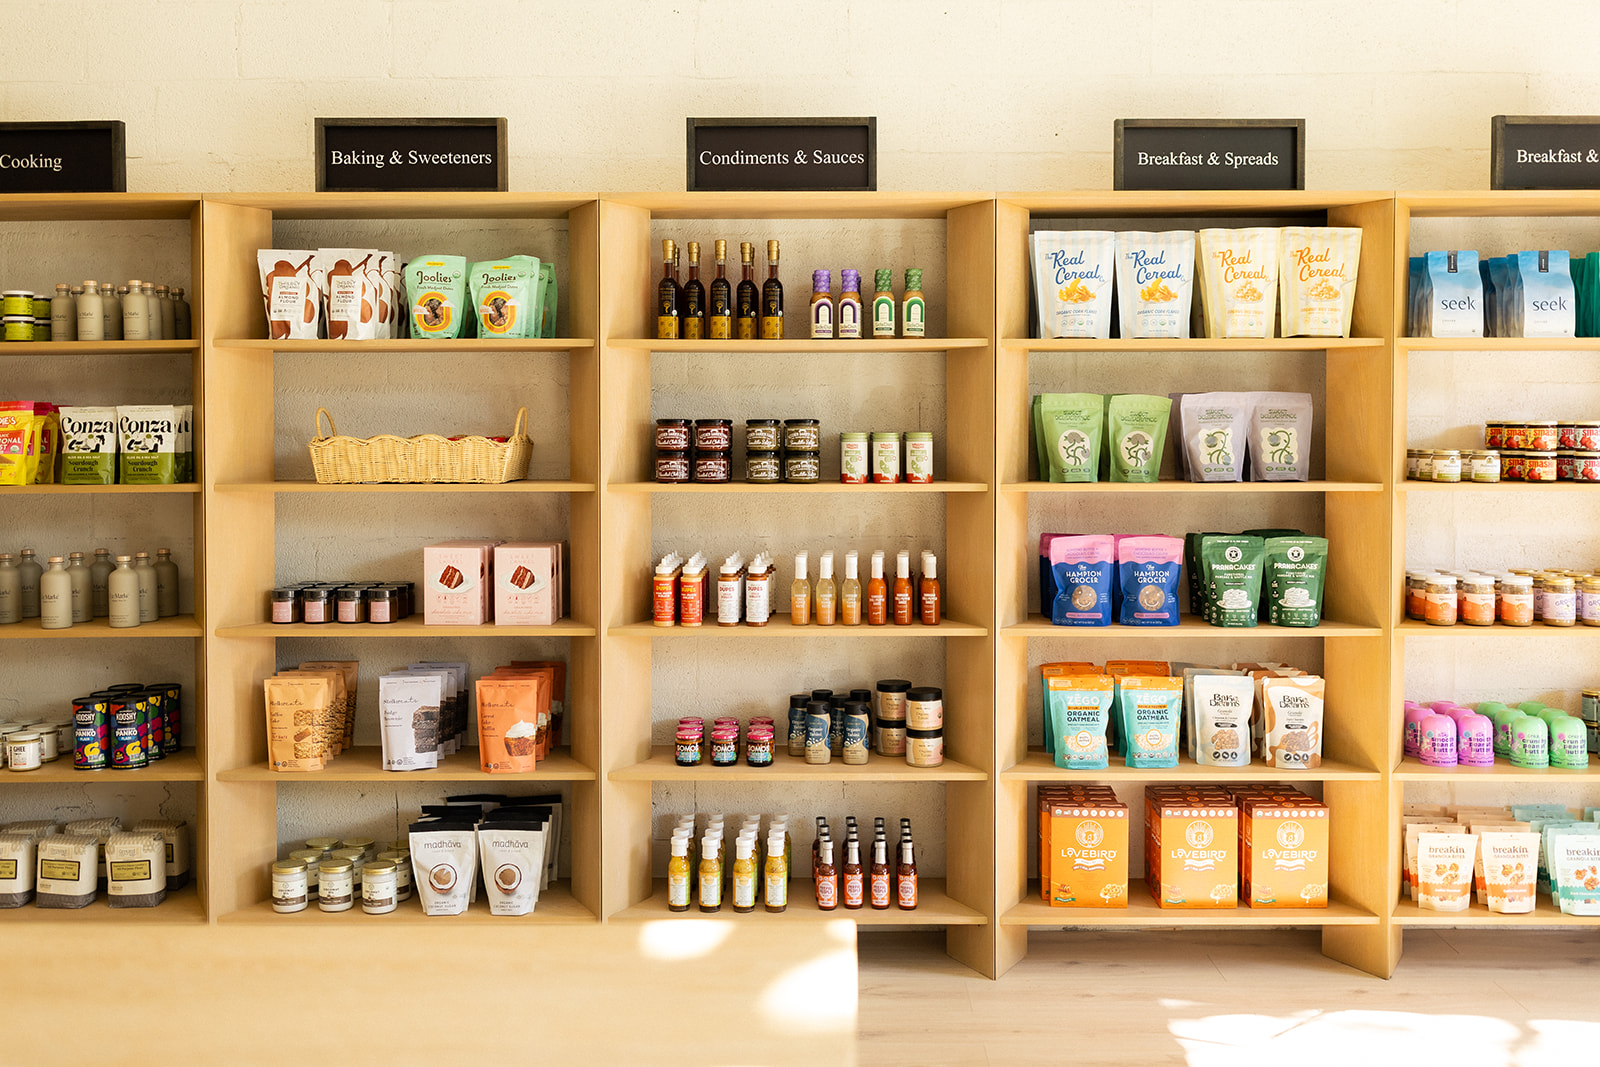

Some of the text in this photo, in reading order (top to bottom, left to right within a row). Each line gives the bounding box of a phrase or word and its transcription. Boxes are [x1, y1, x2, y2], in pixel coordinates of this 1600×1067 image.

[0, 153, 62, 172] Cooking
[331, 150, 493, 168] Baking & Sweeteners
[699, 149, 865, 165] Condiments & Sauces
[1137, 151, 1279, 170] Breakfast & Spreads
[1516, 149, 1600, 165] Breakfast &
[1051, 250, 1085, 269] Real
[1132, 250, 1166, 268] Real
[1218, 249, 1252, 267] Real
[1296, 246, 1331, 266] Real
[416, 271, 452, 284] Joolies
[482, 274, 516, 285] Joolies
[1055, 264, 1100, 284] Cereal
[1136, 264, 1182, 284] Cereal
[1224, 265, 1266, 283] Cereal
[1300, 263, 1345, 282] Cereal
[1441, 296, 1476, 310] seek
[1532, 296, 1567, 311] seek
[62, 416, 114, 434] Conza
[120, 416, 172, 434] Conza
[116, 712, 136, 721] KOOSHY
[424, 840, 461, 849] madhāva
[492, 840, 528, 848] madhāva
[1061, 848, 1116, 861] LOVEBIRD
[1171, 848, 1226, 862] LOVEBIRD
[1262, 848, 1317, 862] LOVEBIRD
